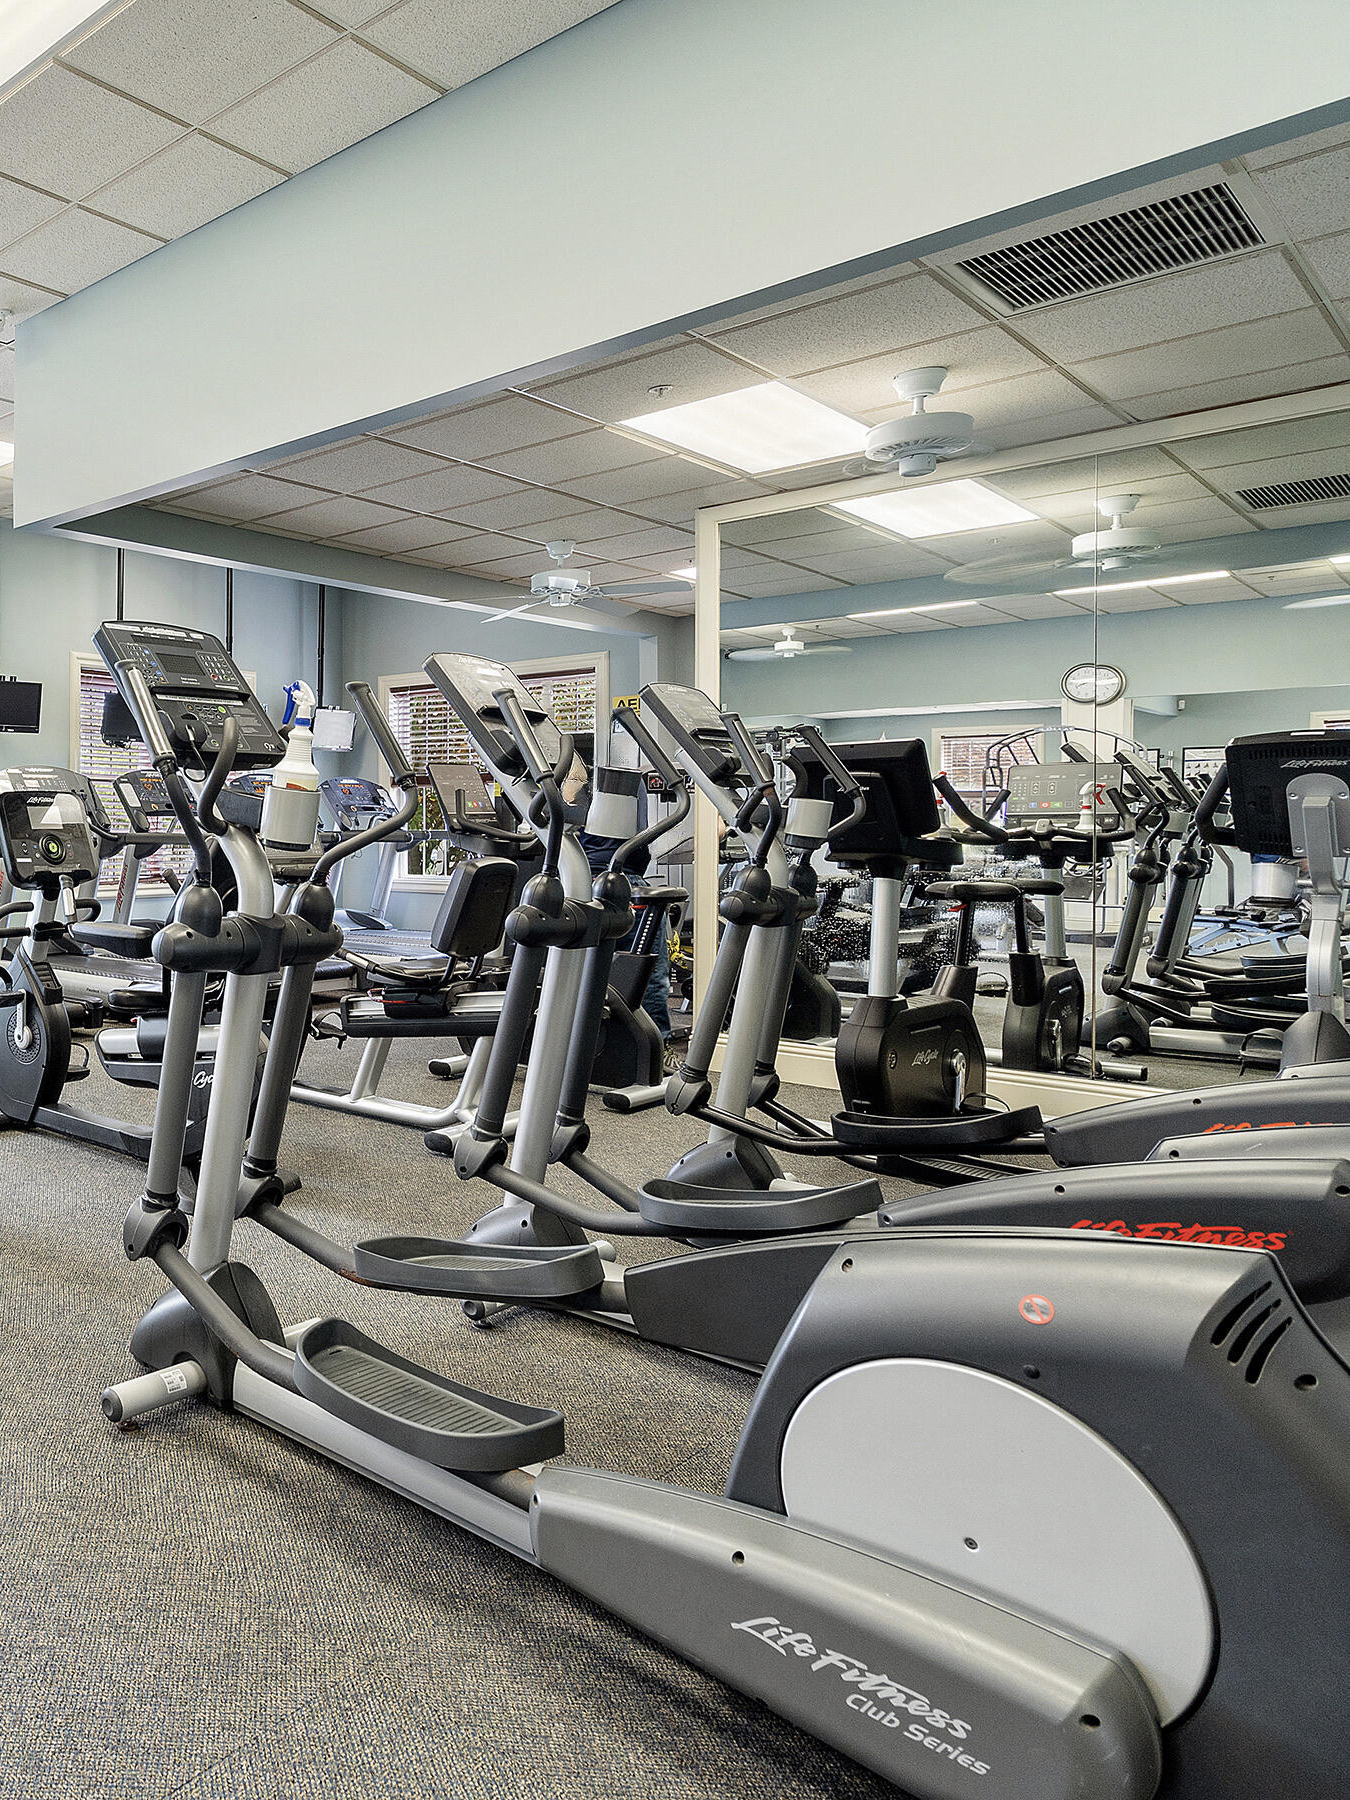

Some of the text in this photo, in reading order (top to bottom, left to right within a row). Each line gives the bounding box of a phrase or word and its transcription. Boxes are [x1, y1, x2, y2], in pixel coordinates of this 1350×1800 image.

[616, 699, 640, 709] AE
[730, 1616, 972, 1740] Life Fitness
[845, 1694, 991, 1776] Club Series
